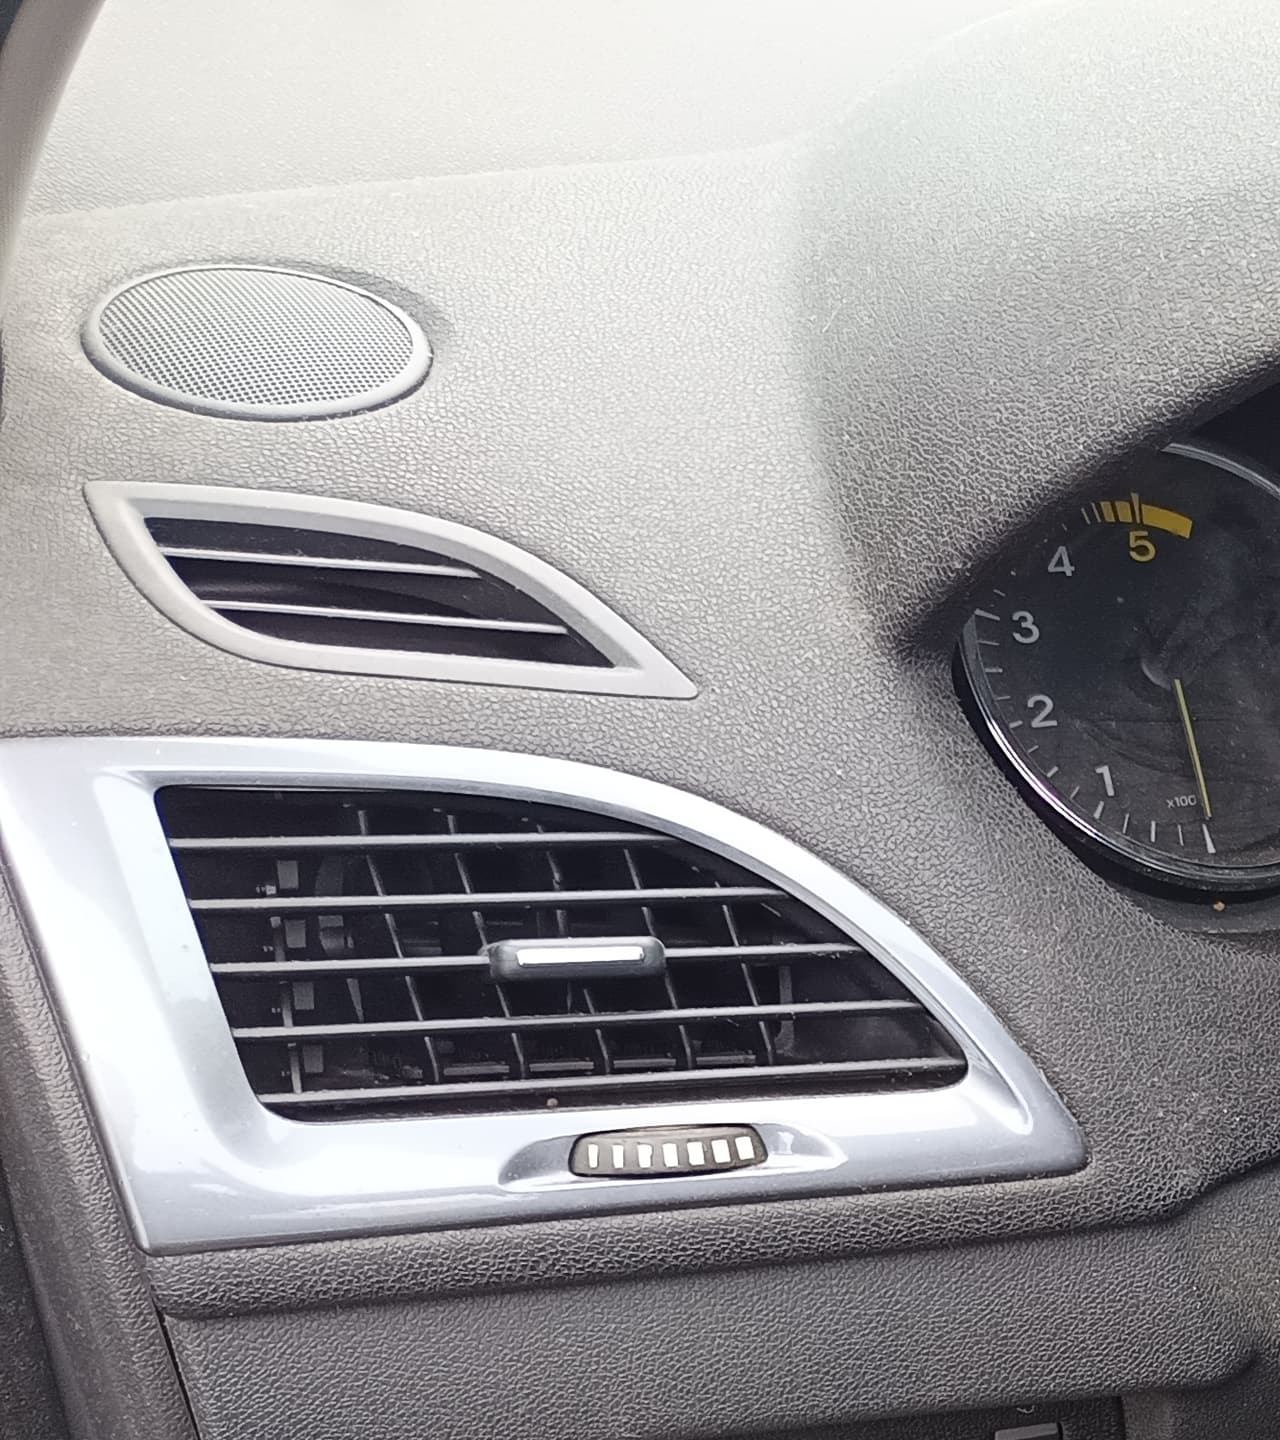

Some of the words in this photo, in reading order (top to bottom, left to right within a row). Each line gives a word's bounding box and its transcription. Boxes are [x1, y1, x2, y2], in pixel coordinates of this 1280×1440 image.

[1047, 547, 1075, 577] 4
[1128, 531, 1156, 562] 5
[1012, 610, 1040, 644] 3
[1026, 695, 1057, 728] 2
[1096, 765, 1115, 797] 1
